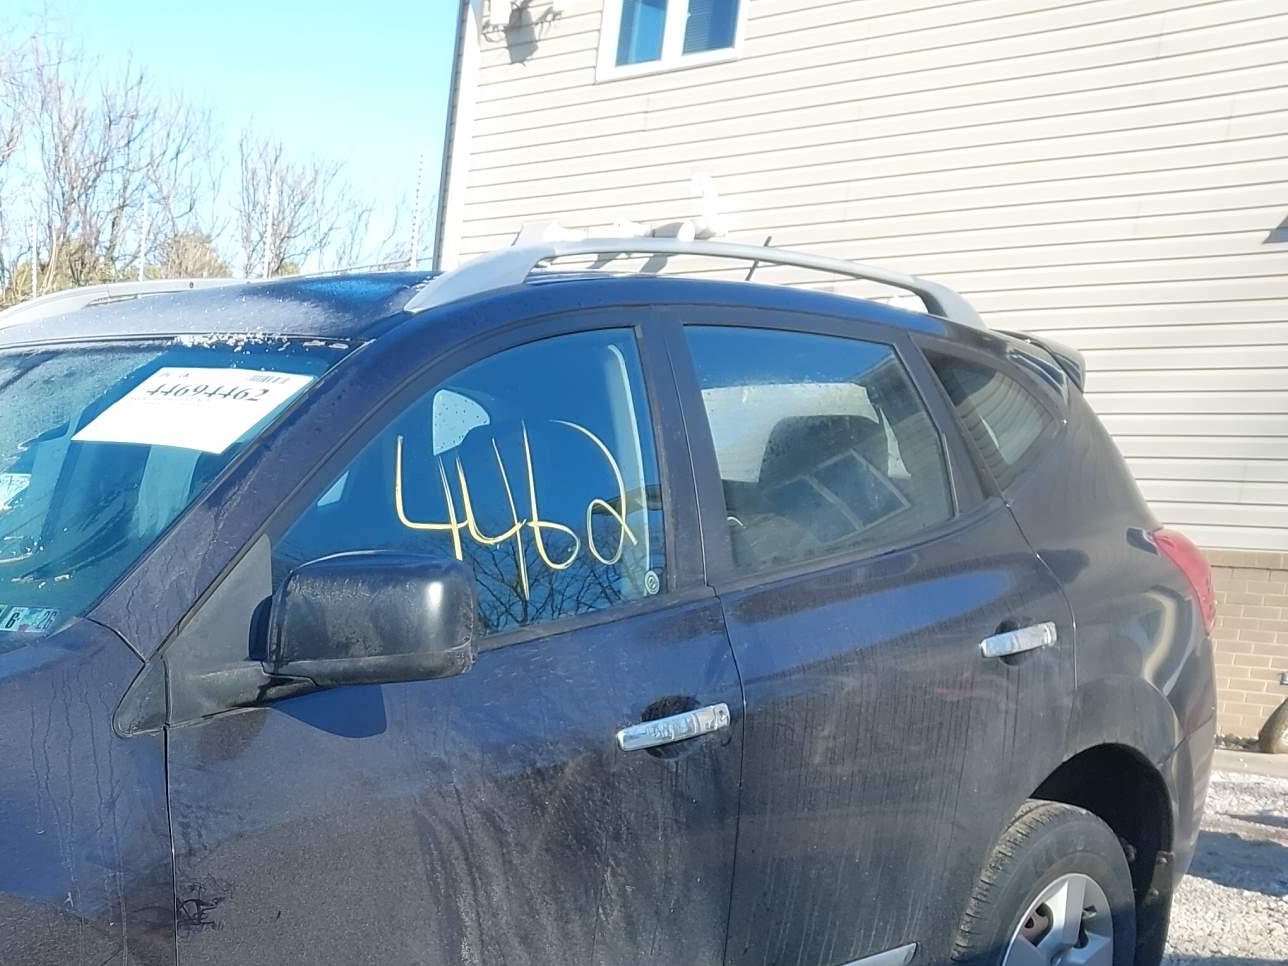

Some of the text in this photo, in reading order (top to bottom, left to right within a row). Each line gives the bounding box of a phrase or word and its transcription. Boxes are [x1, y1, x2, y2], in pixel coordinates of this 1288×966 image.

[146, 383, 269, 402] 44694462
[395, 419, 638, 600] 4462
[5, 612, 20, 629] 6
